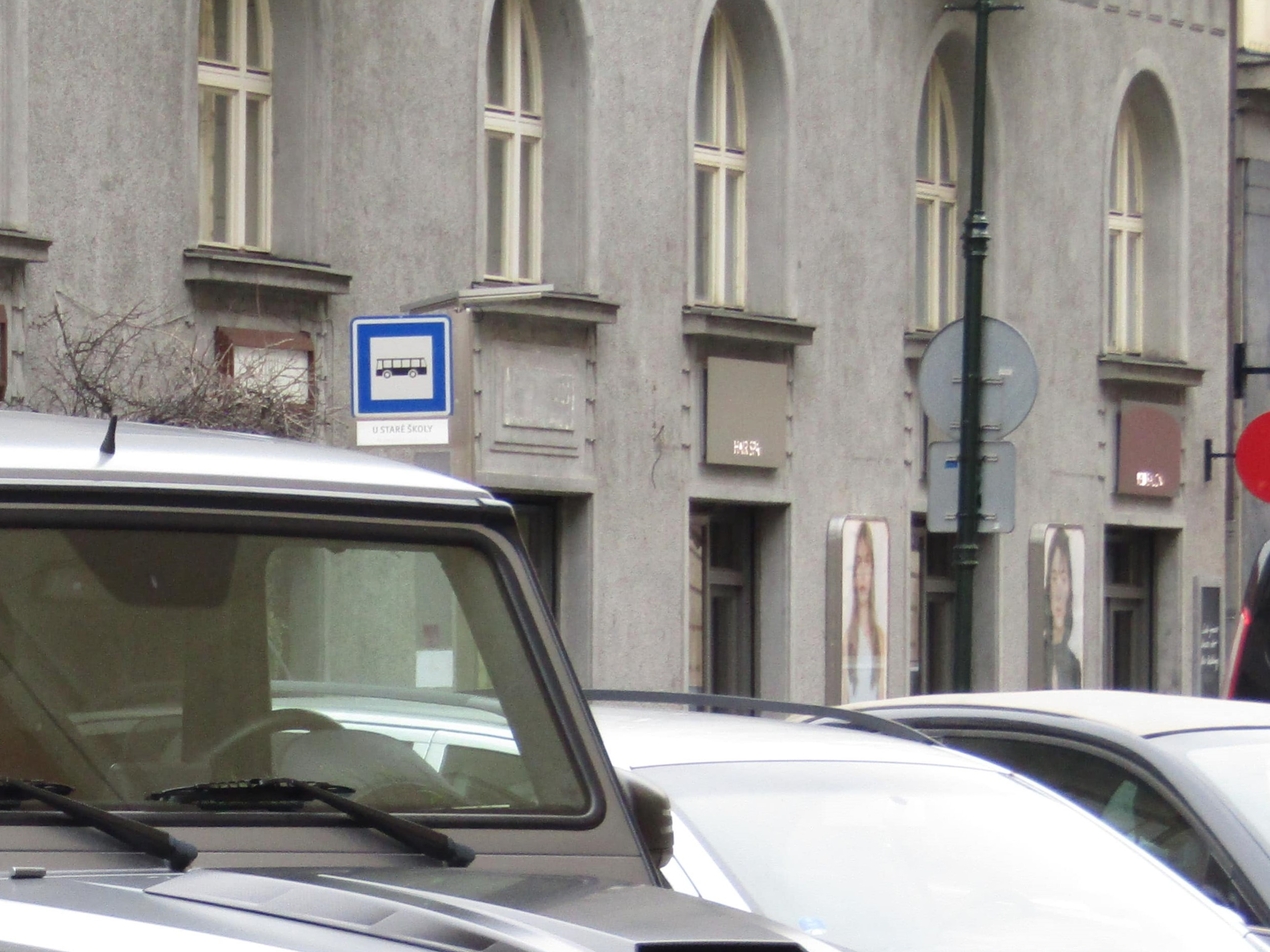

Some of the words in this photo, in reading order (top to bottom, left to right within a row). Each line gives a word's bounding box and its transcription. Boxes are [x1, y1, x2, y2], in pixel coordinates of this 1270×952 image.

[372, 426, 379, 434] U
[380, 424, 405, 434] STARÉ
[407, 423, 433, 434] ŠKOLY
